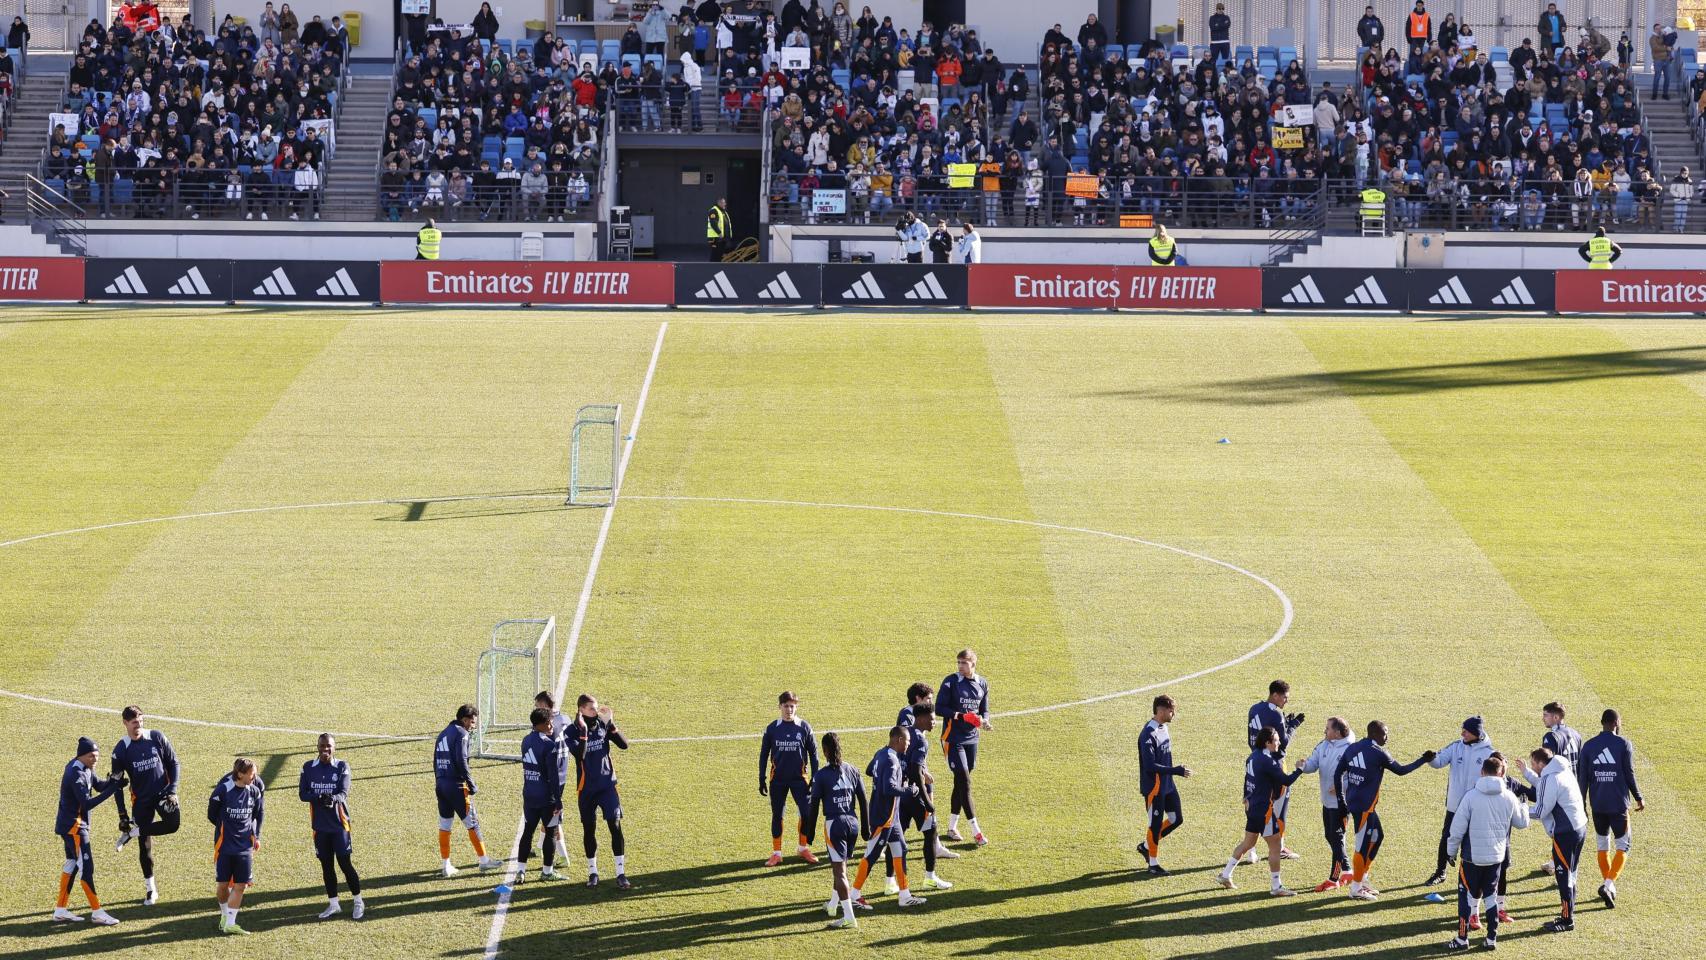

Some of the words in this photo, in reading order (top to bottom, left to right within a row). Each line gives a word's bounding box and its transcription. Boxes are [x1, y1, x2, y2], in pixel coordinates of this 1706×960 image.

[0, 267, 39, 290] TTER
[427, 270, 534, 294] Emirates
[543, 271, 570, 294] FLY
[573, 272, 630, 295] BETTER
[1014, 274, 1120, 298] Emirates
[1130, 276, 1157, 299] FLY
[1160, 276, 1216, 299] BETTER
[1601, 279, 1706, 302] Emirates
[133, 756, 159, 768] Emirates
